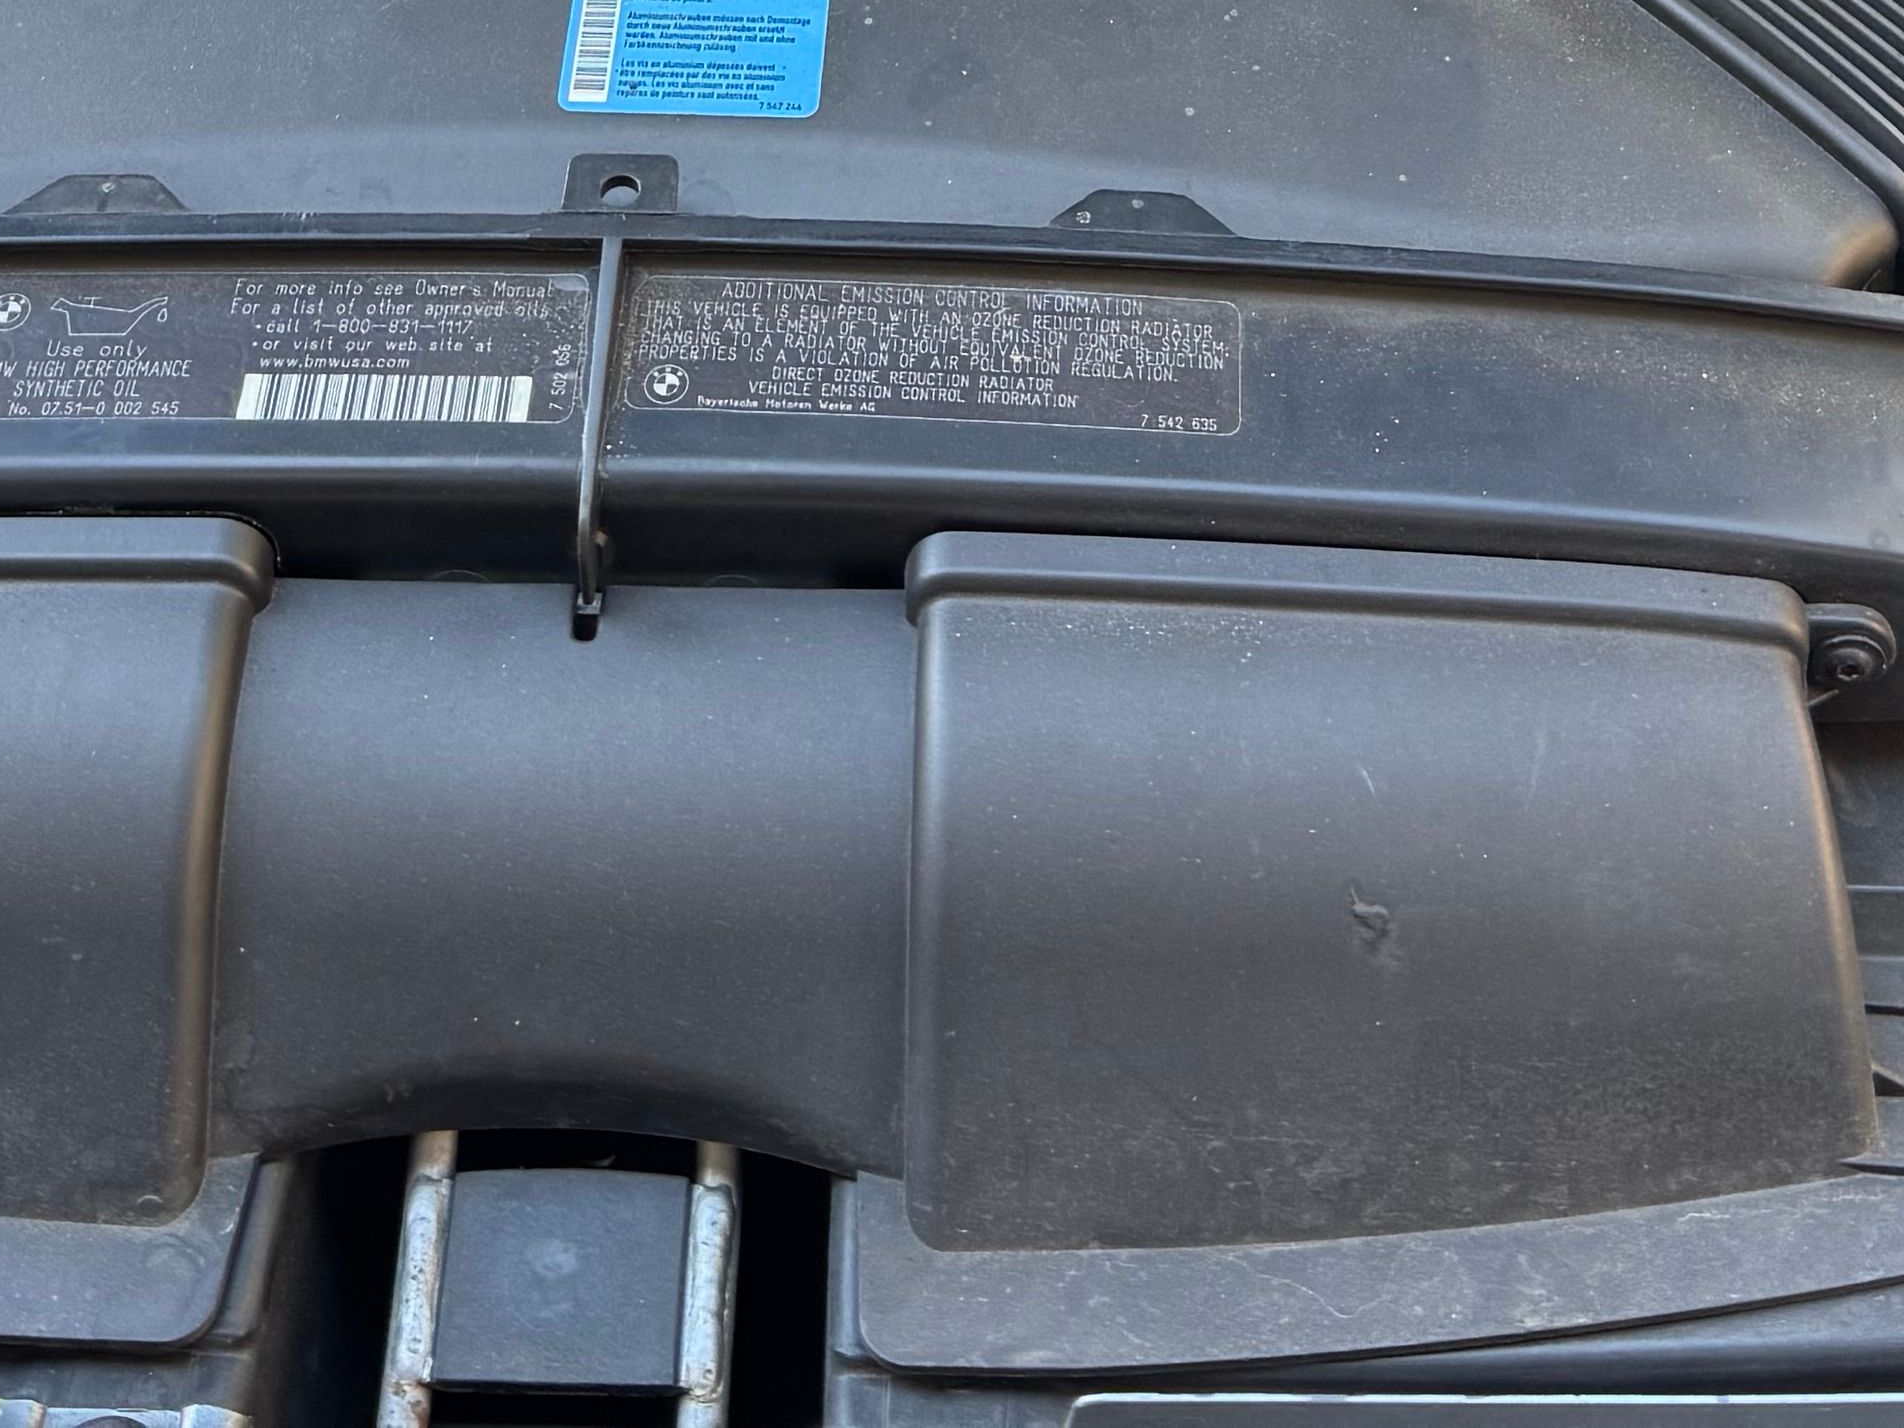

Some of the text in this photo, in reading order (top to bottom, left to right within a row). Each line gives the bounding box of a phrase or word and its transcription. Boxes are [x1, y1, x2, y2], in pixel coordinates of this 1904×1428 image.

[235, 278, 263, 295] For
[275, 283, 316, 295] more
[329, 279, 363, 295] info
[374, 284, 403, 295] see
[231, 297, 260, 315] For
[271, 303, 281, 315] a
[293, 297, 324, 315] list
[336, 298, 355, 315] of
[366, 298, 413, 316] other
[721, 282, 1143, 316] ADDITIONAL EMISSION CONTROL INFORMATION
[266, 318, 299, 333] call
[693, 301, 764, 317] VEHICLE
[774, 304, 789, 318] IS
[800, 304, 877, 322] EQUIPPED
[889, 307, 929, 324] WITH
[940, 311, 961, 325] AN
[972, 311, 1022, 327] OZONE
[1033, 315, 1120, 333] REDUCTION
[1131, 320, 1213, 339] RADIATOR
[644, 316, 684, 330] THAT
[696, 316, 712, 331] IS
[722, 317, 744, 331] AN
[755, 318, 828, 334] ELEMENT
[839, 321, 859, 335] OF
[872, 322, 900, 337] THE
[911, 323, 980, 342] VEHICLE
[992, 327, 1068, 345] EMISSION
[1079, 333, 1146, 350] CONTROL
[47, 339, 147, 360] Use only
[262, 336, 492, 352] or visit our web site at
[641, 330, 1224, 370] CHANGING TO A RADIATOR WITHOUT EQUIVALENT OZONE REDUCTION
[26, 359, 65, 377] HIGH
[74, 359, 193, 378] PERFORMANCE
[260, 354, 410, 368] www.bmwusa.com
[639, 344, 737, 361] PROPERTIES
[749, 347, 764, 362] IS
[775, 349, 786, 363] A
[799, 349, 888, 367] VIOLATION
[899, 353, 916, 368] OF
[930, 355, 958, 370] AIR
[1071, 361, 1179, 382] REGULATION.
[13, 379, 140, 397] SYNTHETIC OIL
[772, 366, 1054, 391] DIRECT OZONE REDUCTION RADIATOR
[749, 380, 1077, 408] VEHICLE EMISSION CONTROL INFORMATION
[8, 401, 31, 415] No.
[114, 401, 142, 415] 002
[151, 401, 180, 415] 545
[860, 401, 875, 412] AG
[1141, 414, 1217, 431] 7 542 635
